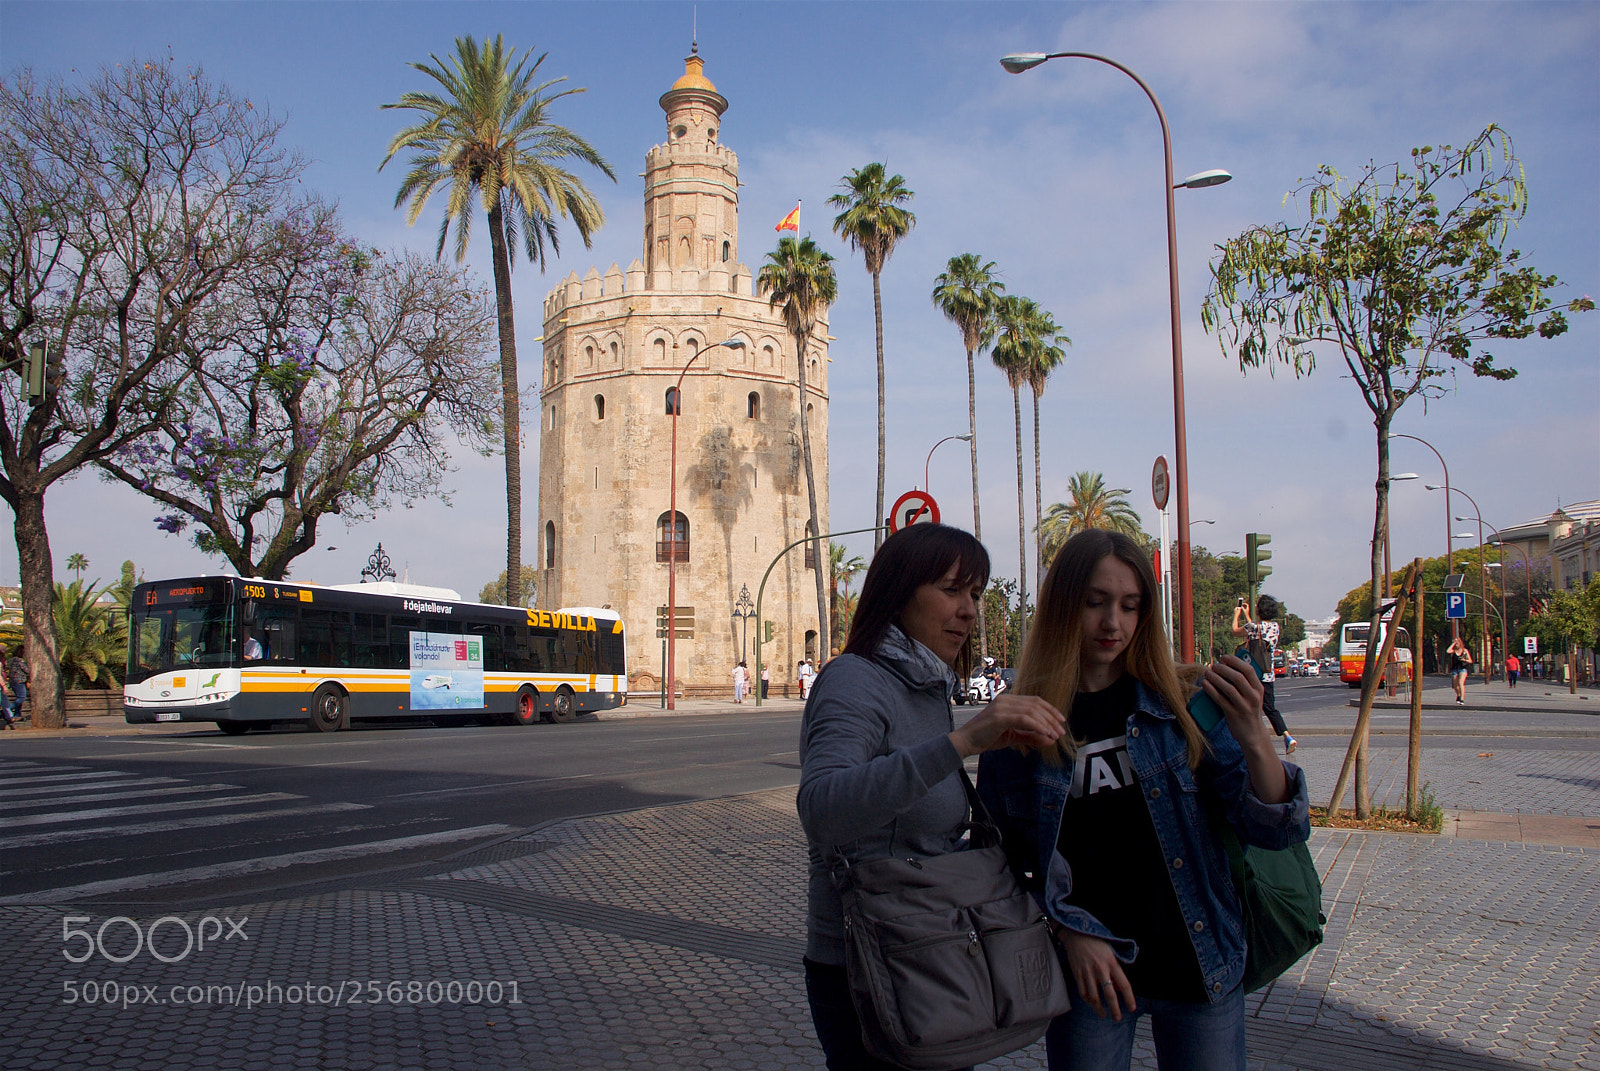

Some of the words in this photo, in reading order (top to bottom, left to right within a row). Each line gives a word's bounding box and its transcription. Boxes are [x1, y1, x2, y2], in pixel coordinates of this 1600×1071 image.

[169, 586, 204, 597] AEROPUERTO
[403, 599, 453, 614] #dejatellevar
[1450, 595, 1462, 609] P
[526, 608, 597, 632] SEVILLA
